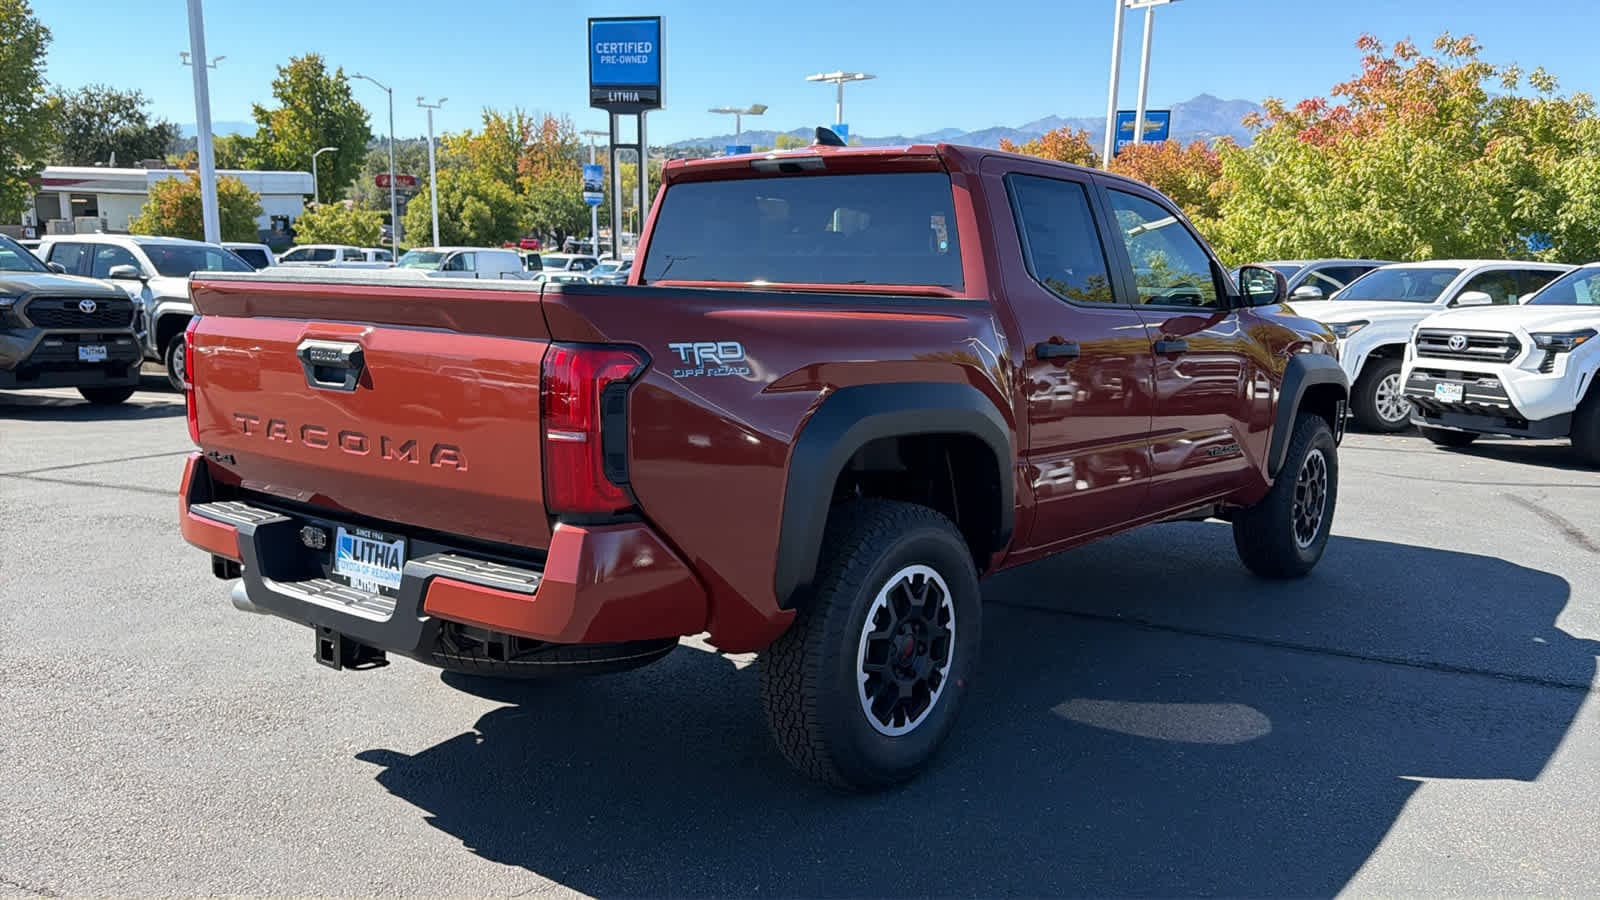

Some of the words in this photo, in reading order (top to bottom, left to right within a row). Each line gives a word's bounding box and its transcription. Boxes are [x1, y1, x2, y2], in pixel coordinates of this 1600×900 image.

[596, 42, 653, 54] CERTIFIED
[600, 55, 648, 65] PRE-OWNED
[608, 91, 640, 103] LITHIA
[668, 341, 746, 368] TRD
[672, 367, 705, 379] OFF
[706, 366, 752, 378] ROAD
[233, 412, 469, 472] TACOMA
[355, 528, 372, 539] SINCE
[352, 539, 401, 572] LITHIA
